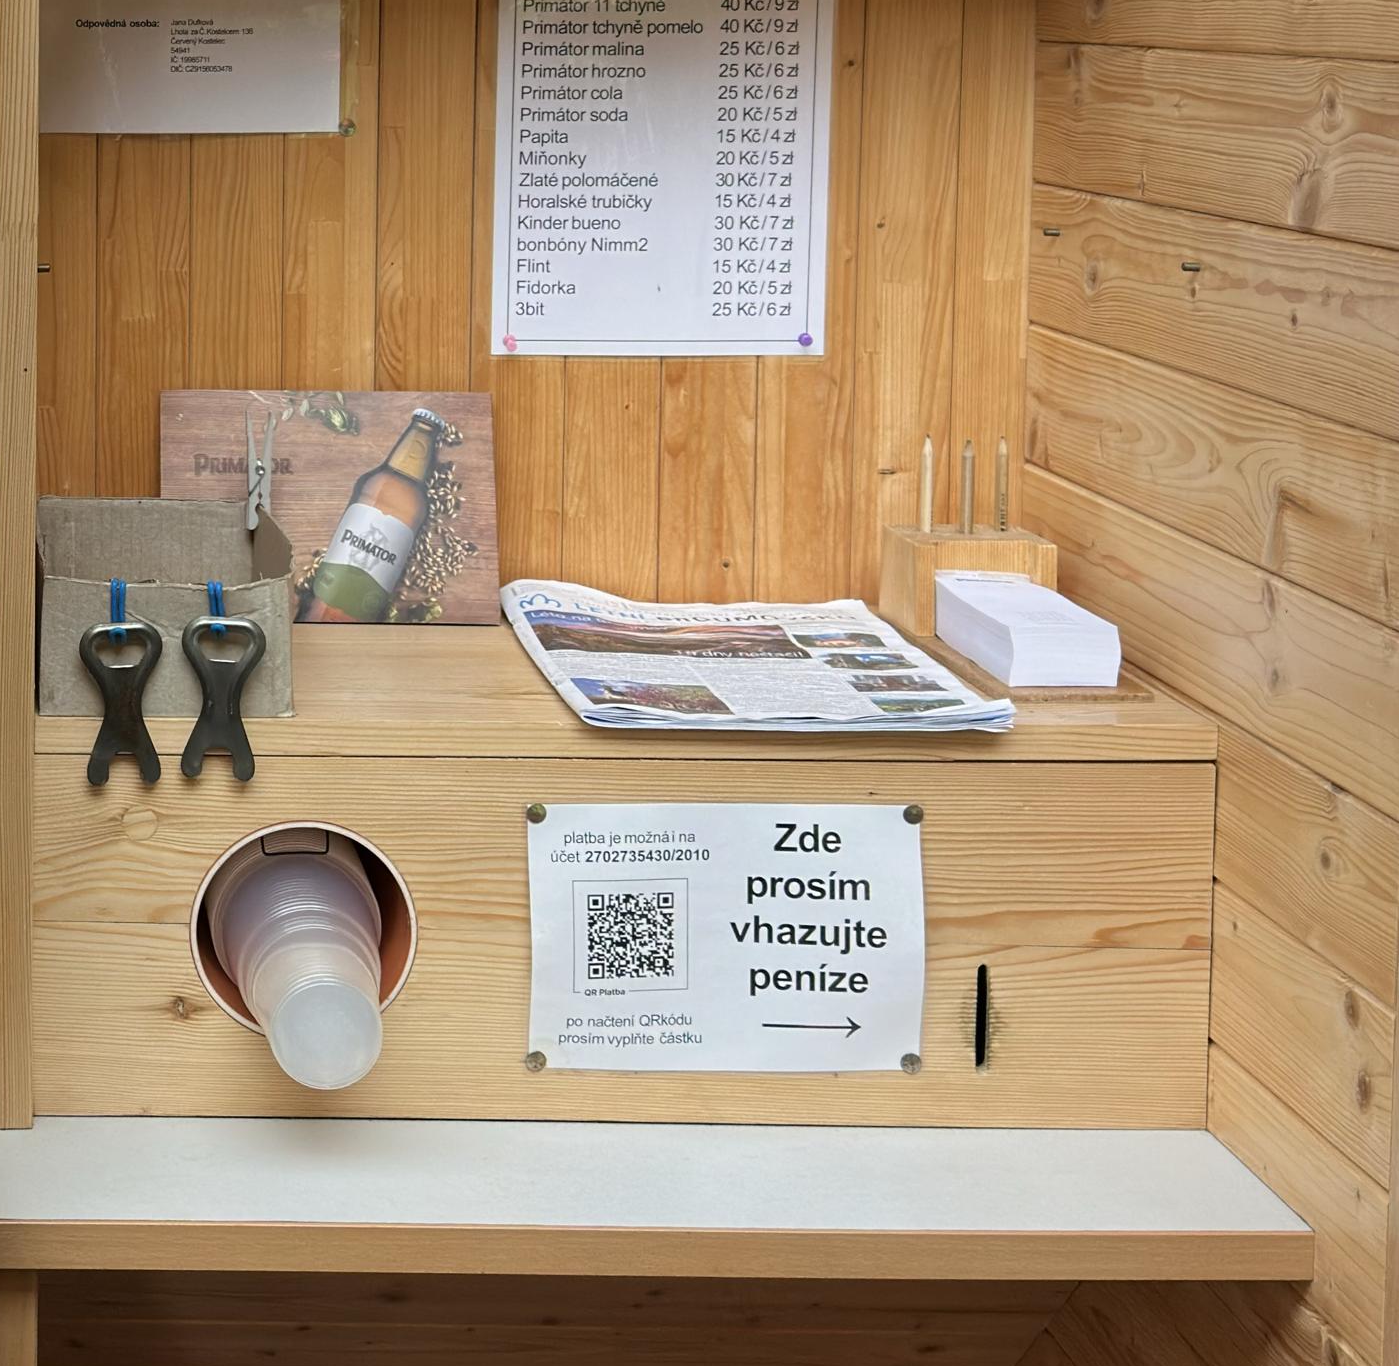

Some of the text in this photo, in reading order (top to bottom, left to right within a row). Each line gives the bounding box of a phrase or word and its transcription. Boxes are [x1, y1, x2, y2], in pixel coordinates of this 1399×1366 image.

[76, 19, 126, 28] Odpovědná
[523, 20, 703, 37] Primátor tchyně pomelo
[520, 129, 568, 146] Papita
[520, 151, 586, 169] Miňonky
[519, 173, 658, 190] Zlaté polomáčené
[517, 259, 550, 273] Flint
[517, 280, 575, 294] Fidorka
[516, 302, 544, 315] 3bit
[564, 832, 605, 846] platba
[609, 832, 621, 847] je
[624, 831, 670, 844] možná
[679, 834, 695, 842] na
[774, 824, 841, 853] Zde
[551, 849, 709, 863] účet 2702735430/2010
[748, 871, 870, 904] prosím
[730, 915, 887, 954] vhazujte
[750, 964, 868, 996] peníze
[567, 1014, 692, 1028] po načtení QRkódu
[559, 1032, 702, 1047] prosím vyplňte částku
